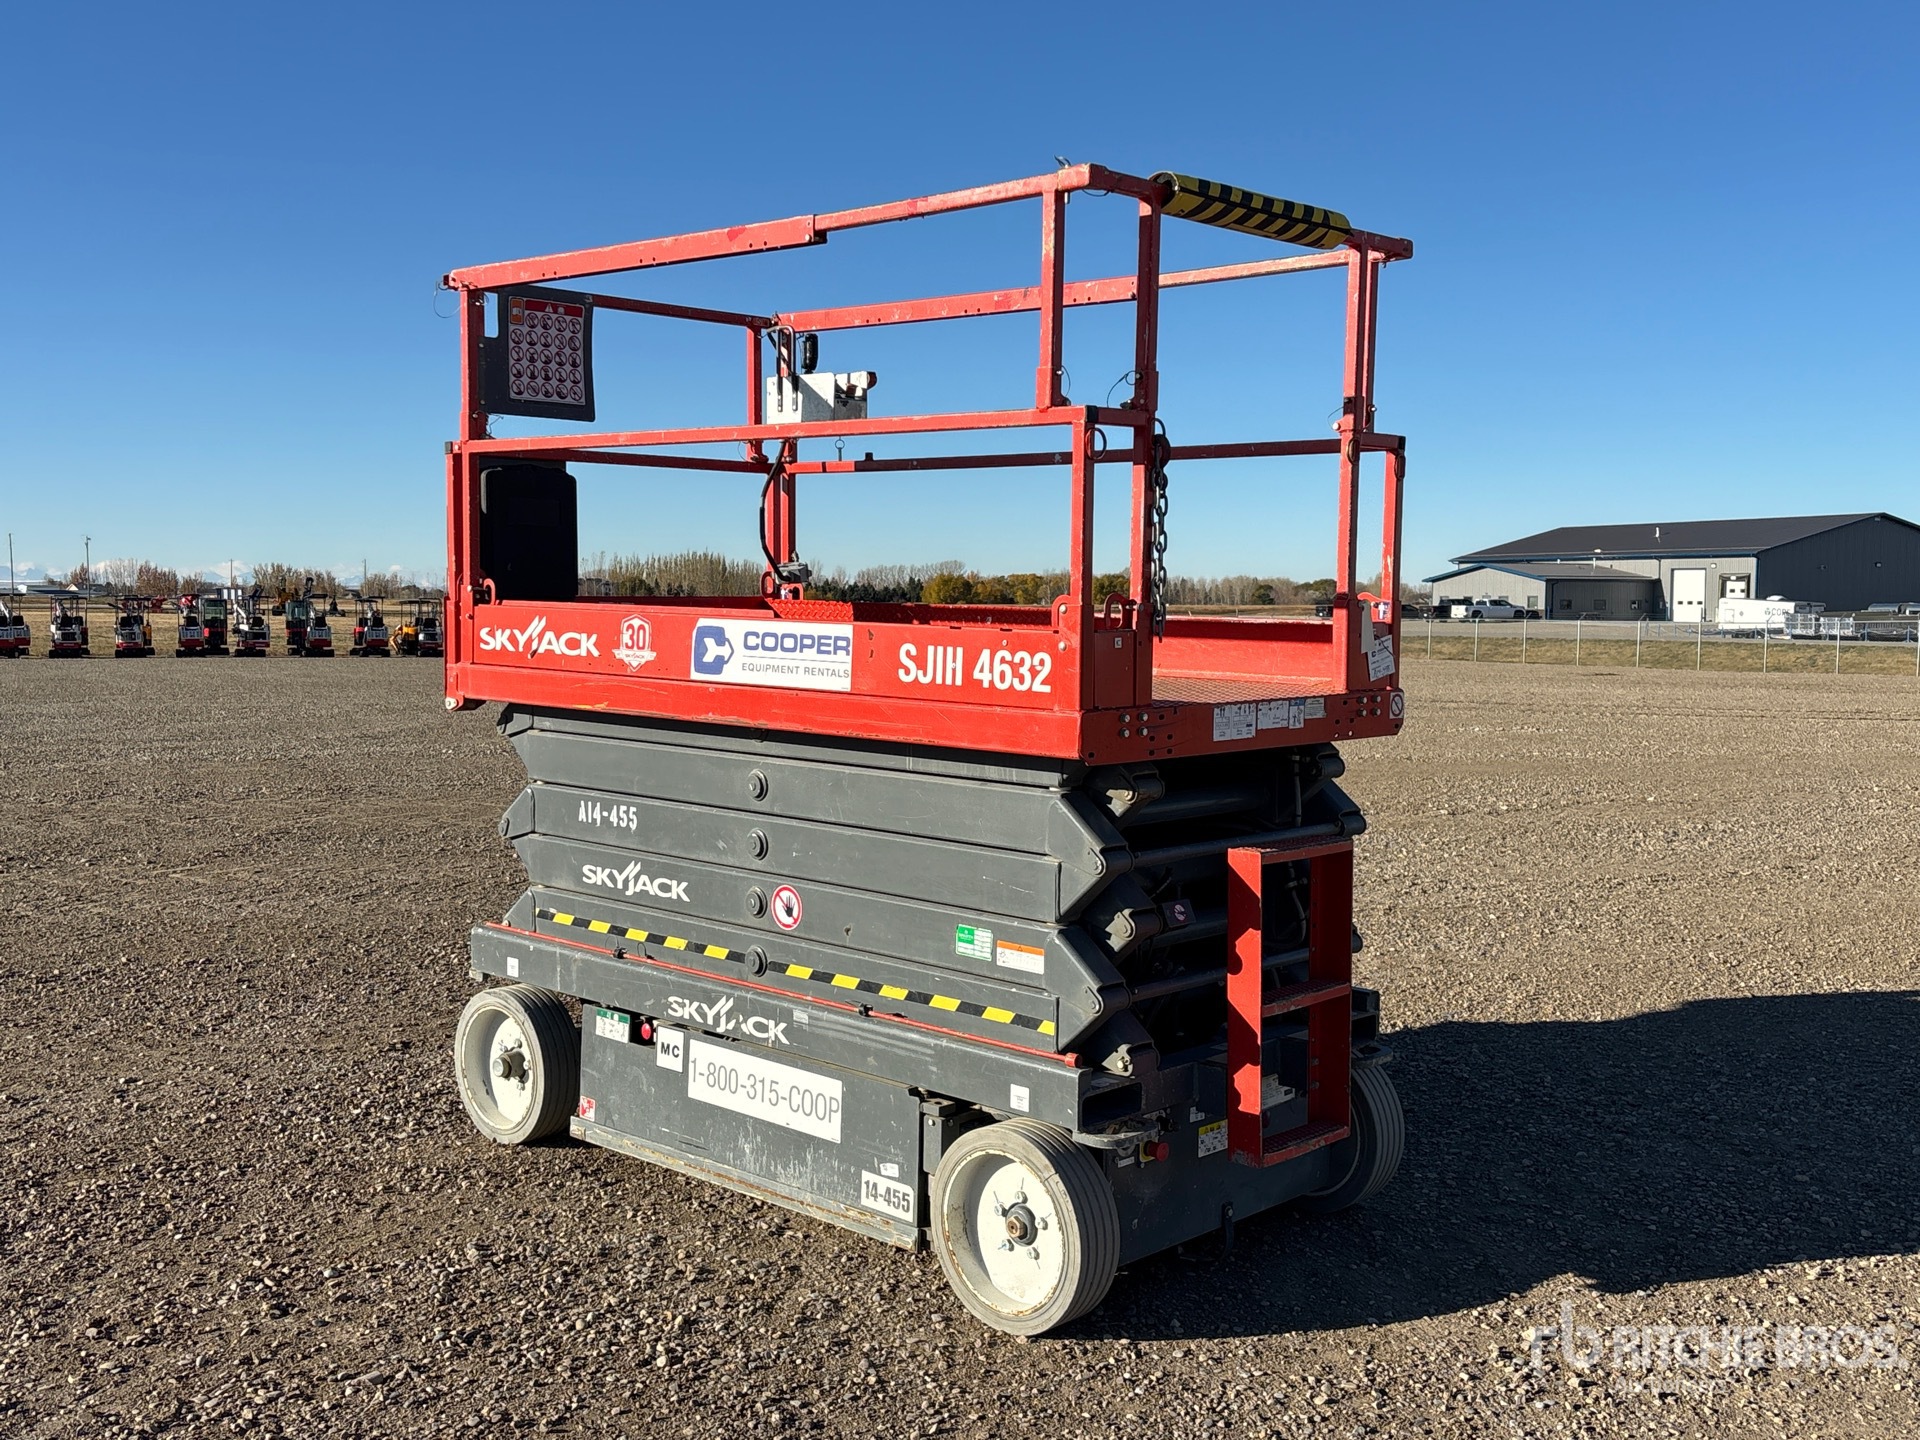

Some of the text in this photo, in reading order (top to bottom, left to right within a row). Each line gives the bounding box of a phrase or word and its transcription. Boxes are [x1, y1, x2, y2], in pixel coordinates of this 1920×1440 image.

[479, 615, 600, 660] SKYJACK
[625, 623, 646, 650] 30
[743, 631, 851, 656] COOPER
[742, 662, 850, 679] EQUIPMENT RENTALS
[973, 648, 1052, 693] 4632
[578, 800, 638, 831] A14-455
[582, 860, 690, 902] SKYJACK
[660, 1042, 680, 1059] MC
[691, 1057, 840, 1123] 1-800-315-COOP
[864, 1180, 911, 1214] 14-455
